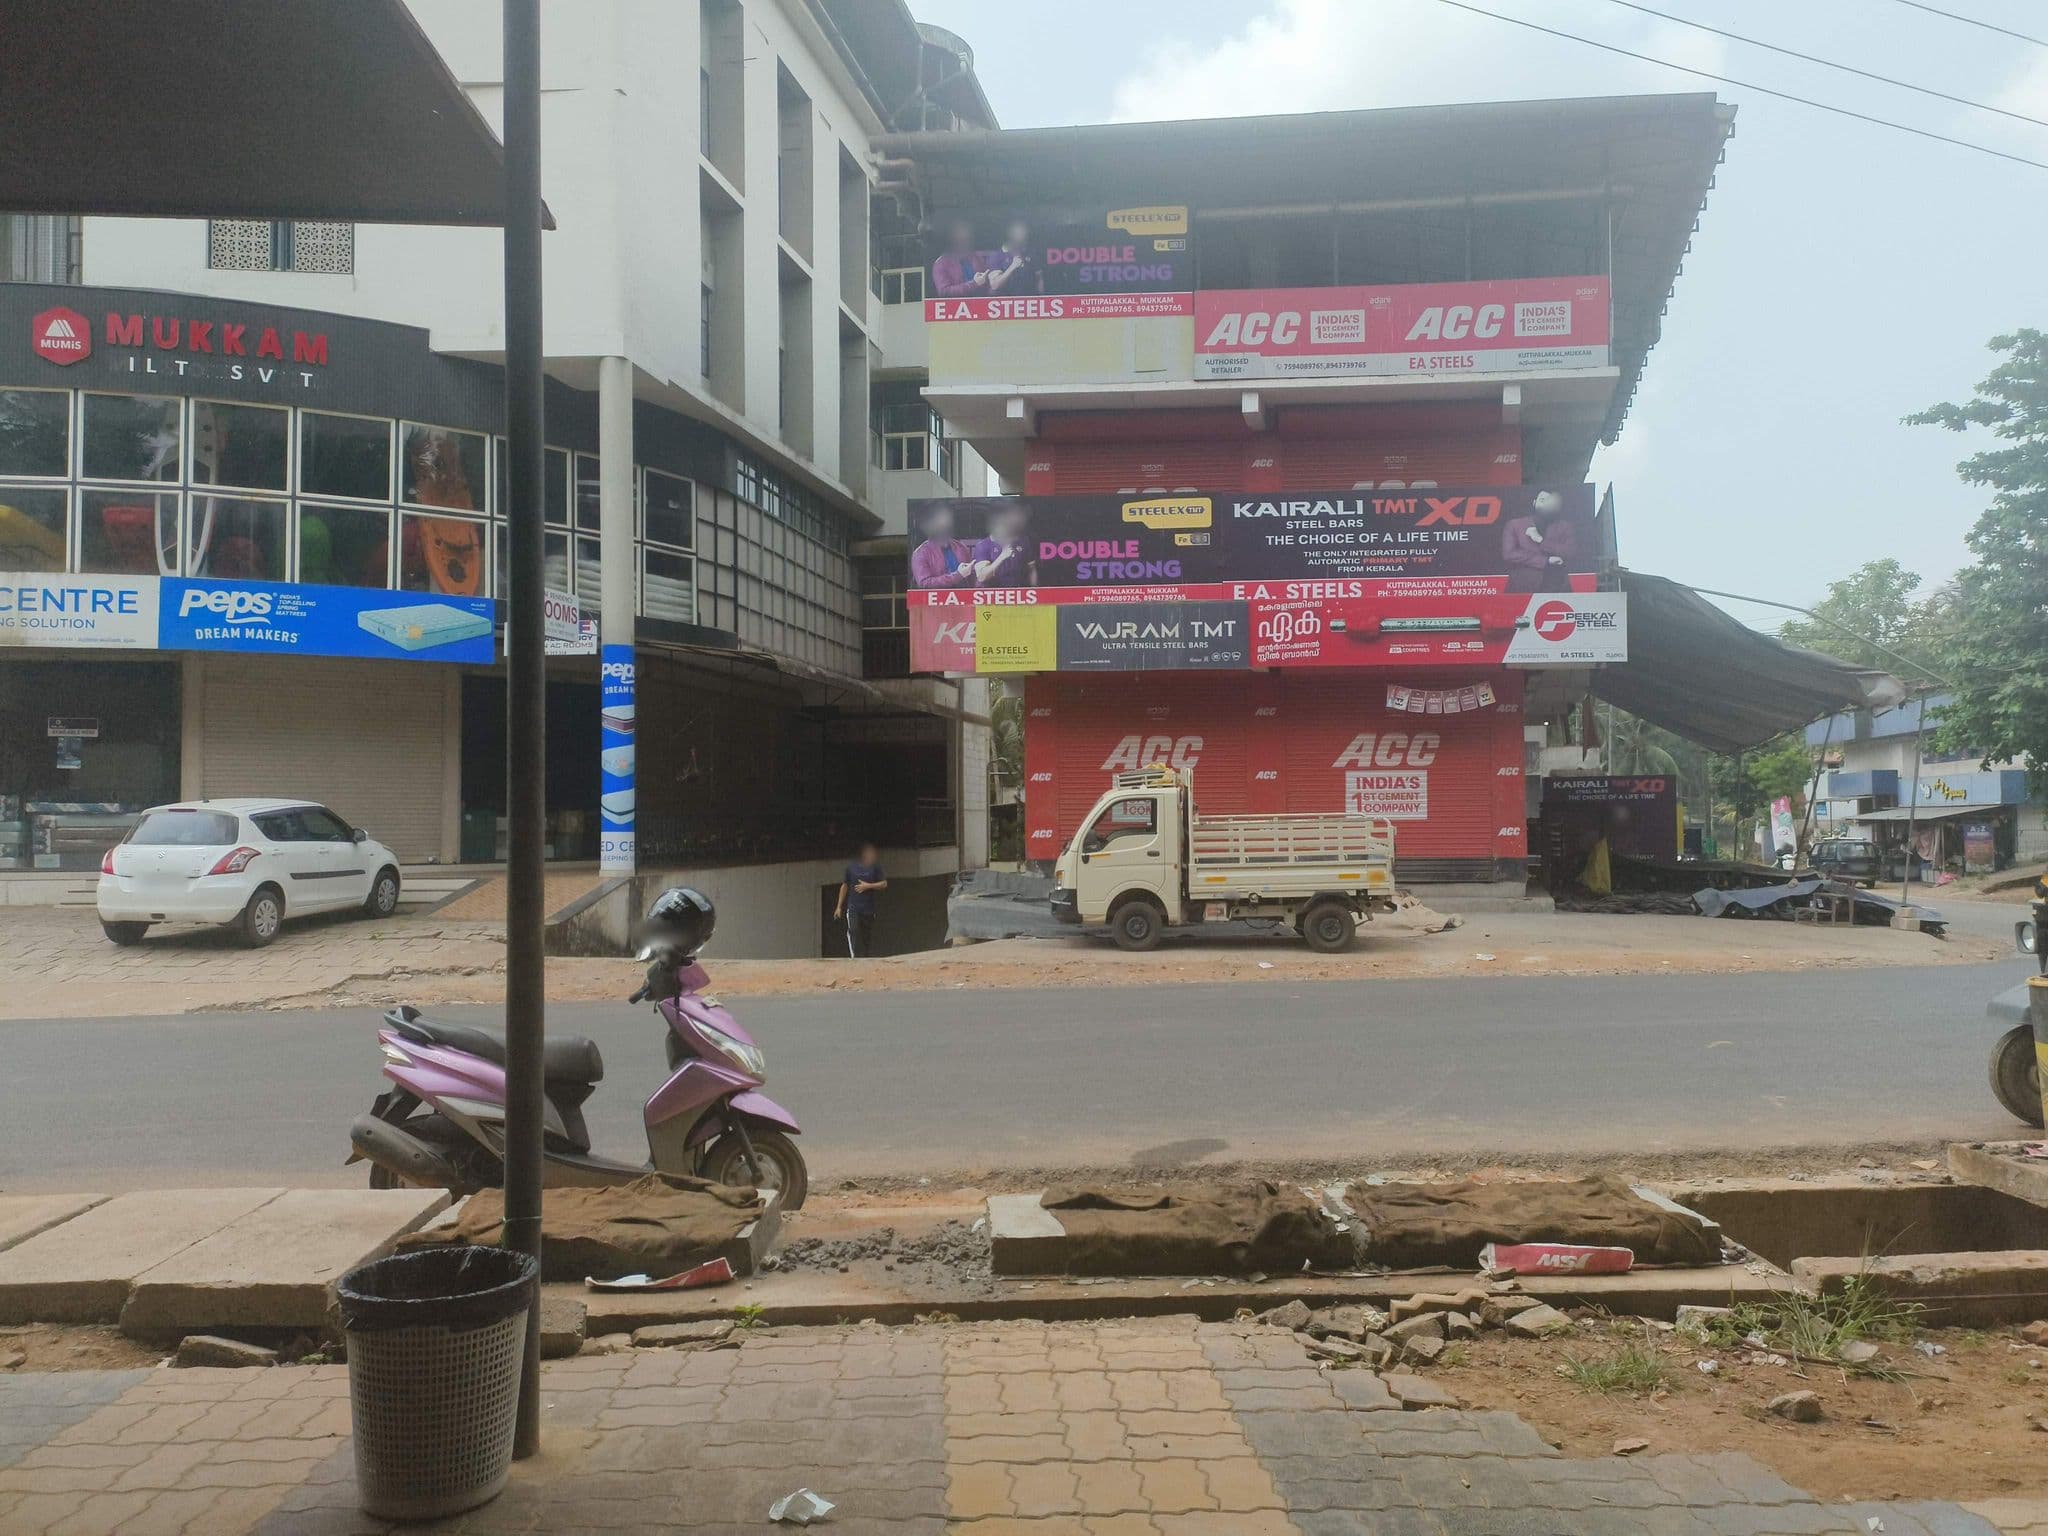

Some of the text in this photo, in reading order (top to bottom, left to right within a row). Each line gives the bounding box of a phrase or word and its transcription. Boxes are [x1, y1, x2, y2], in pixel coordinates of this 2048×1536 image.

[1046, 246, 1135, 265] DOUBLE
[1079, 264, 1173, 283] STRONG
[934, 299, 1064, 321] E.A. STEELS
[1522, 306, 1566, 317] INDIA'S
[1318, 314, 1360, 325] INDIA'S
[1404, 304, 1506, 341] ACC
[1204, 311, 1302, 346] ACC
[1331, 324, 1360, 332] CEMENT
[1527, 324, 1566, 332] COMPANY
[105, 312, 329, 366] MUKKAM
[1322, 331, 1361, 339] COMPANY
[1204, 357, 1249, 366] AUTHORISED
[1409, 355, 1474, 370] EA STEELS
[1211, 366, 1242, 374] RETAILER
[1252, 458, 1274, 468] ACC
[1494, 454, 1517, 463] ACC
[1129, 506, 1185, 516] STEELEX
[1233, 496, 1502, 527] KAIRALI TMT XD
[1286, 519, 1364, 530] STEEL BARS
[1265, 530, 1469, 546] THE CHOICE OF A LIFE TIME
[1039, 540, 1140, 560] DOUBLE
[1349, 549, 1407, 557] INTEGRATED
[1076, 559, 1181, 580] STRONG
[1451, 580, 1488, 588] MUKKAM
[1233, 582, 1363, 601] E.A. STEELS
[0, 587, 139, 614] CENTRE
[178, 588, 273, 619] peps
[928, 590, 1037, 607] E.A. STEELS
[1565, 612, 1617, 620] PEEKAY
[20, 617, 96, 629] SOLUTION
[1576, 620, 1617, 628] STEEL
[1075, 620, 1237, 639] VAJRAM TMT
[195, 627, 298, 644] DREAM MAKERS
[981, 646, 1029, 655] EA STEELS
[1102, 641, 1209, 650] ULTRA TENSILE STEEL BARS
[1101, 735, 1204, 770] ACC
[1331, 732, 1441, 768] ACC
[1031, 772, 1052, 782] ACC
[1255, 770, 1278, 780] ACC
[1496, 767, 1520, 776] ACC
[1356, 776, 1420, 790] INDIA'S
[1552, 780, 1609, 789] KAIRALI
[1377, 792, 1420, 801] CEMENT
[1363, 803, 1421, 813] COMPANY
[1031, 829, 1053, 838] ACC
[1498, 827, 1521, 836] ACC
